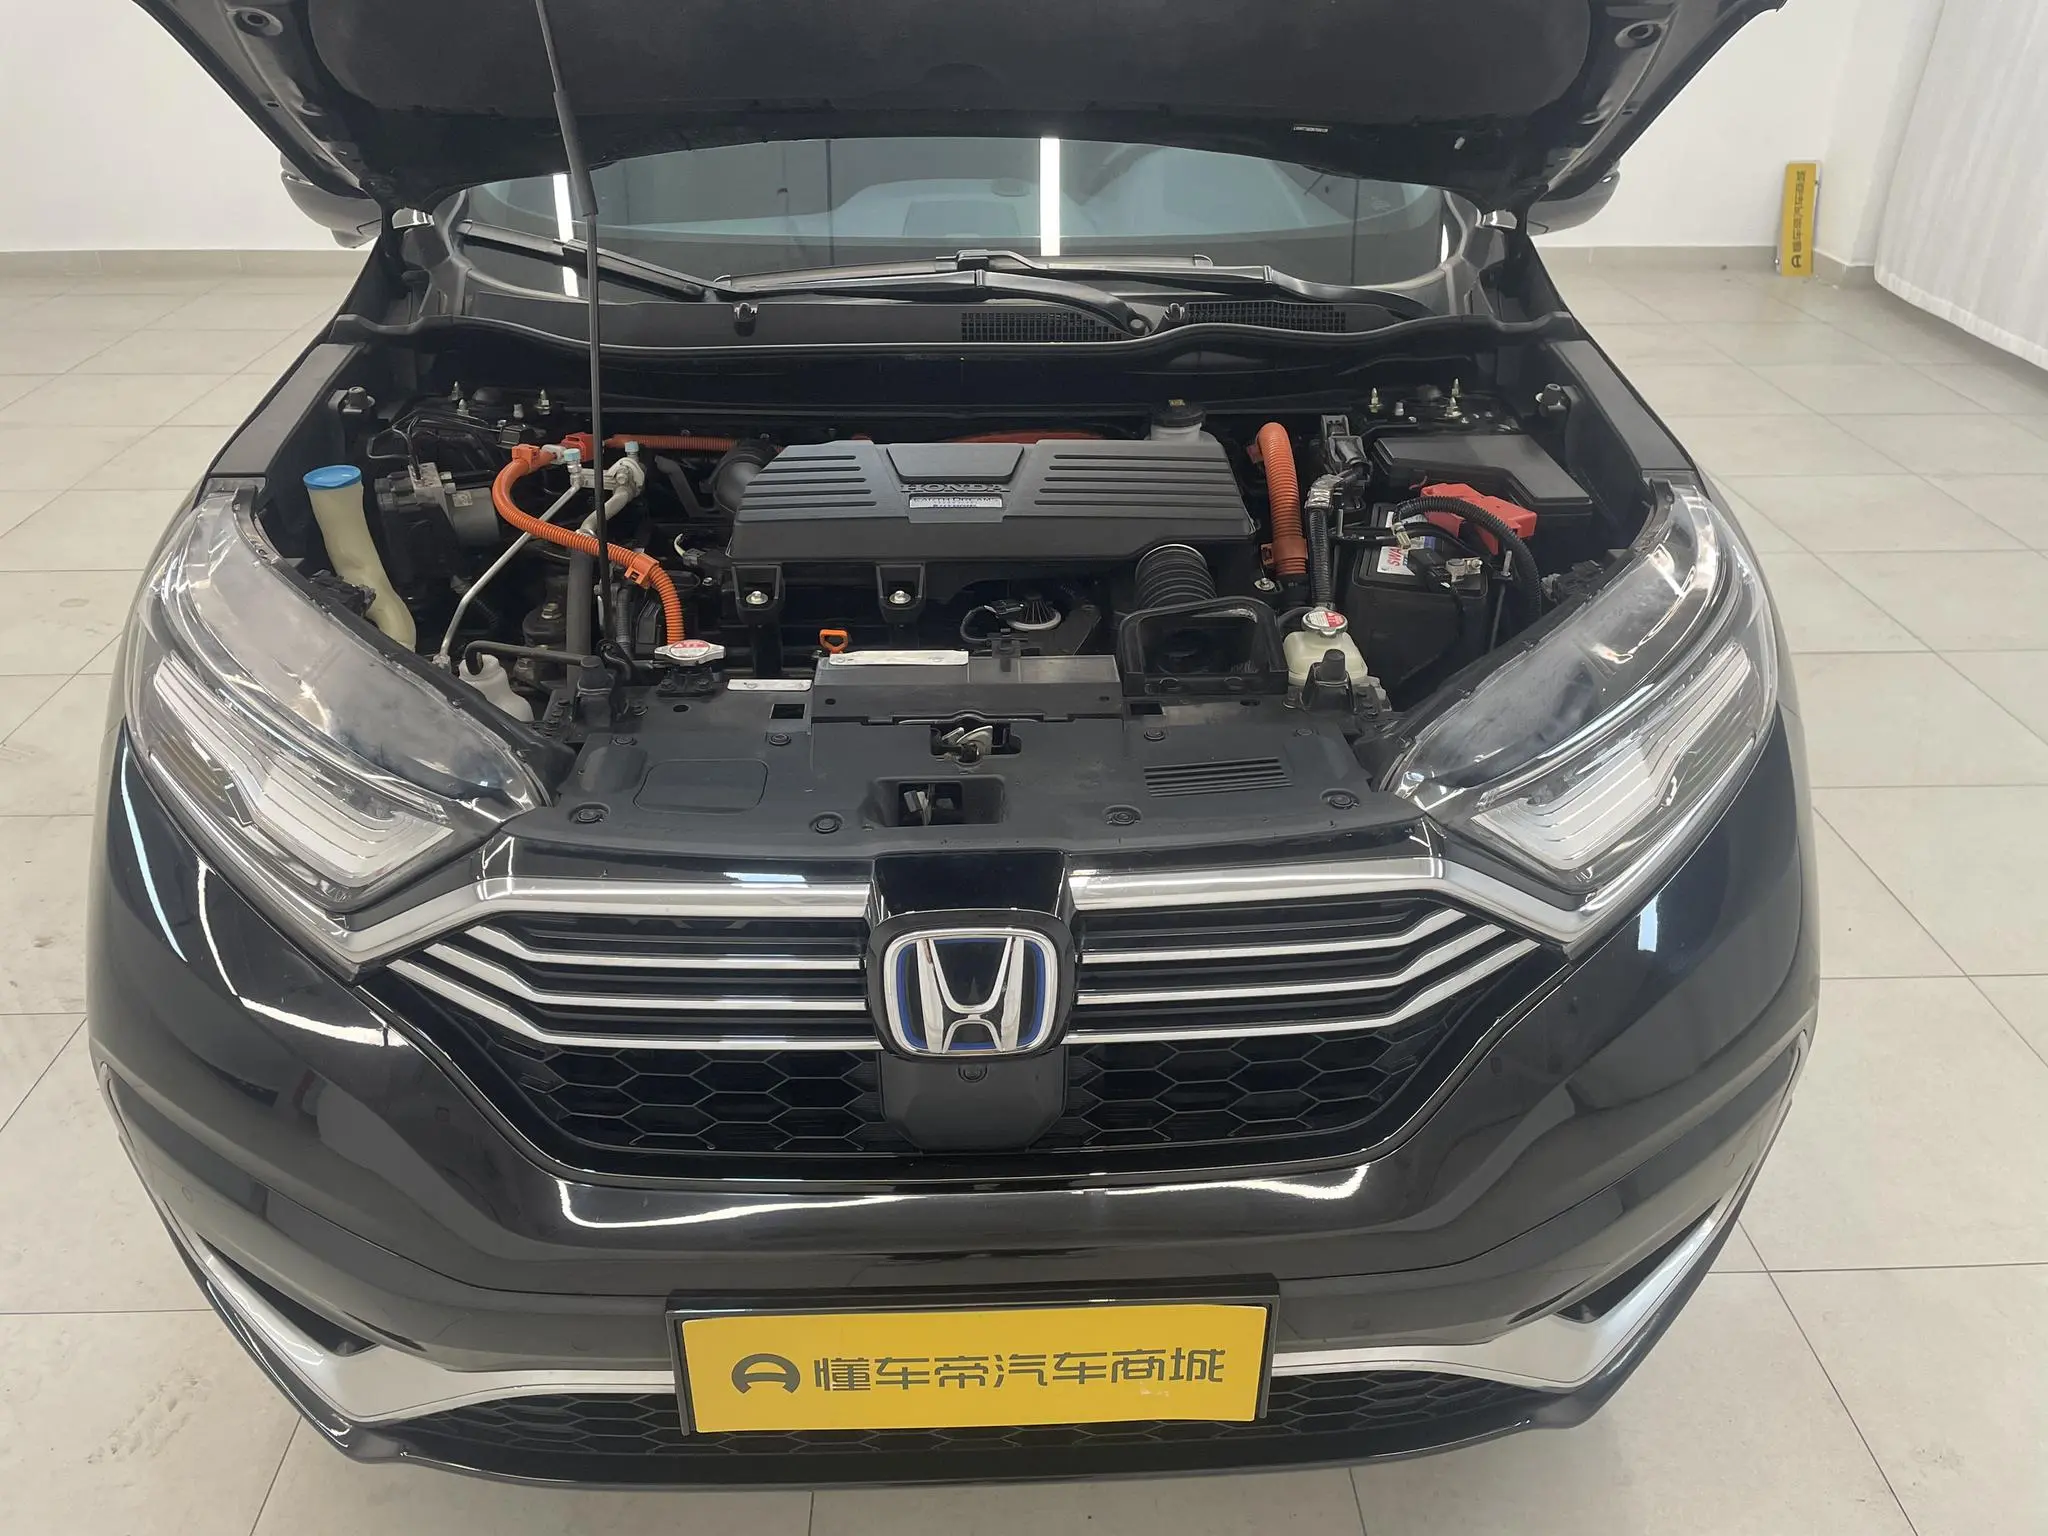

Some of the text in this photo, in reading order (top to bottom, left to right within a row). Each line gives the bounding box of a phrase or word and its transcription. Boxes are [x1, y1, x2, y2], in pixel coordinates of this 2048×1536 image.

[814, 1347, 1226, 1392] 懂车帝汽车商城
